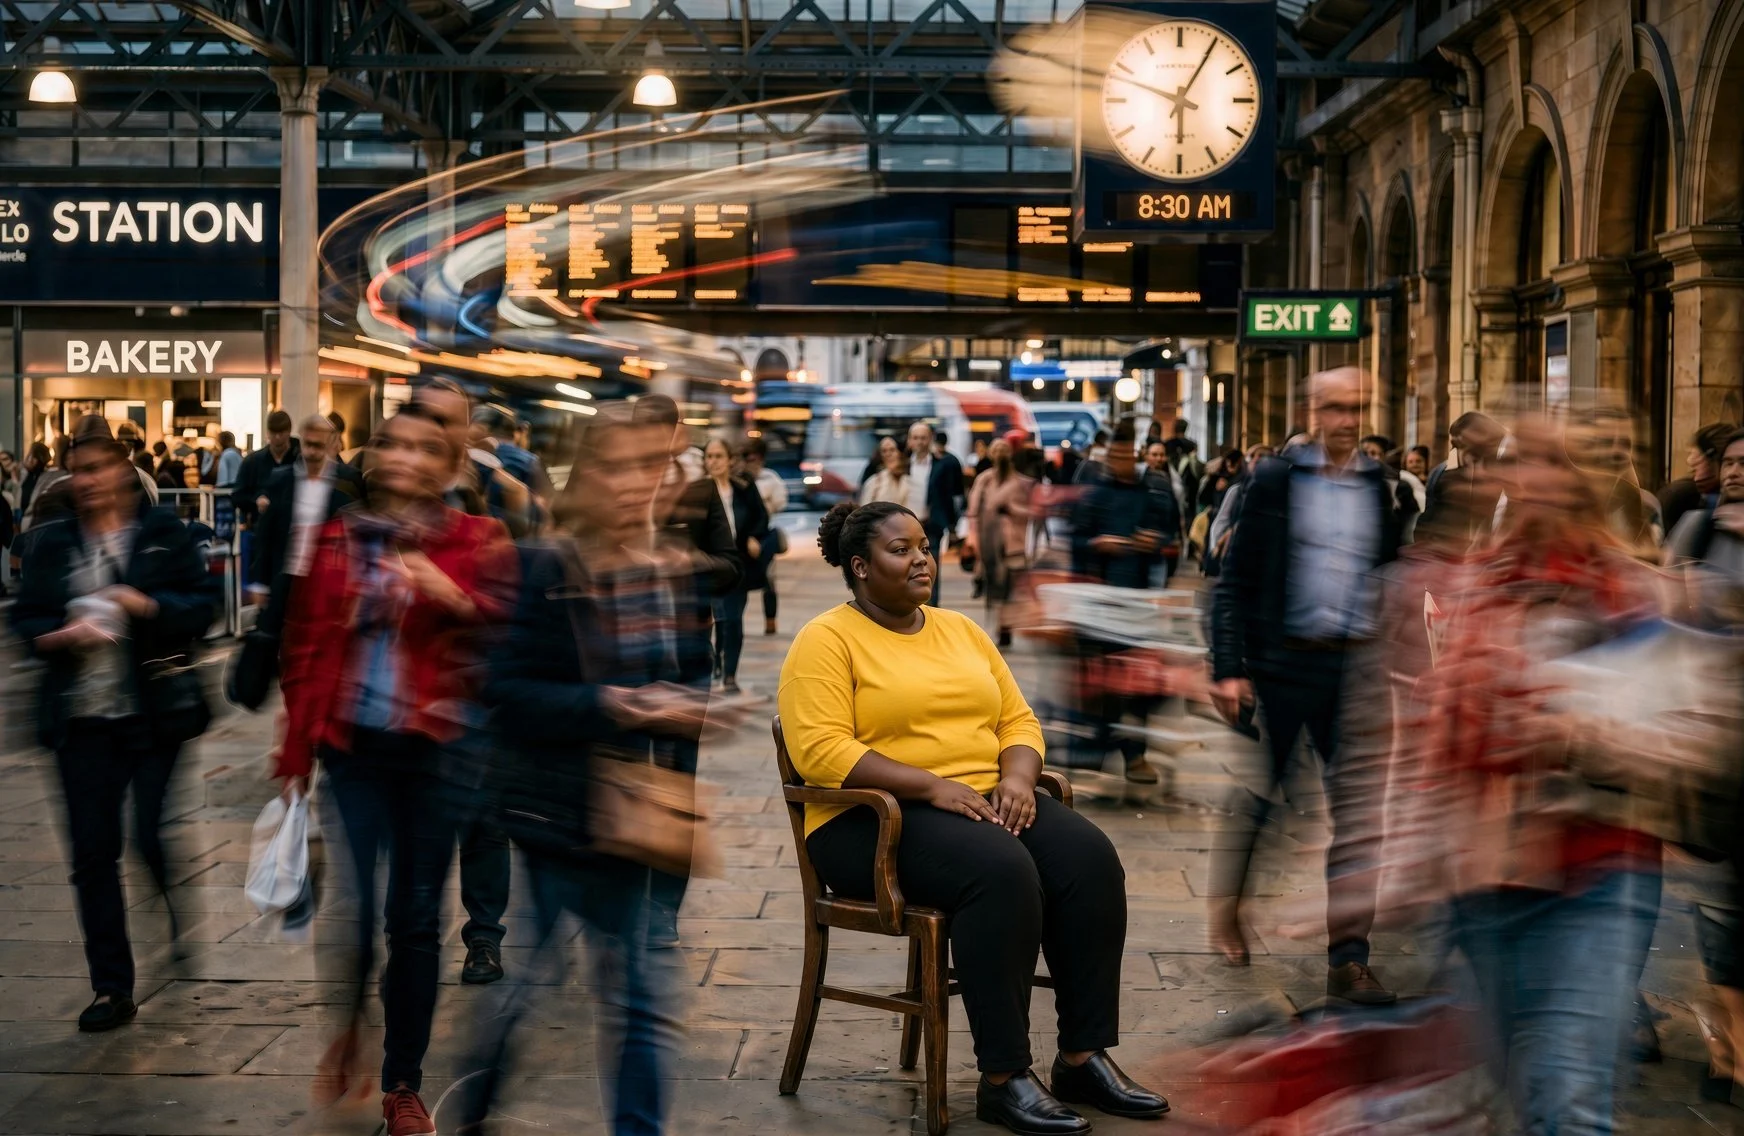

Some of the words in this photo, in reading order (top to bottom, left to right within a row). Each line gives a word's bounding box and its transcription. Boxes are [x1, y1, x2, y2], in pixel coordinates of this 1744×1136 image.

[1138, 194, 1190, 219] 8:30
[1197, 194, 1231, 219] AM
[52, 201, 263, 243] STATION
[1254, 304, 1321, 331] EXIT
[67, 340, 223, 374] BAKERY
